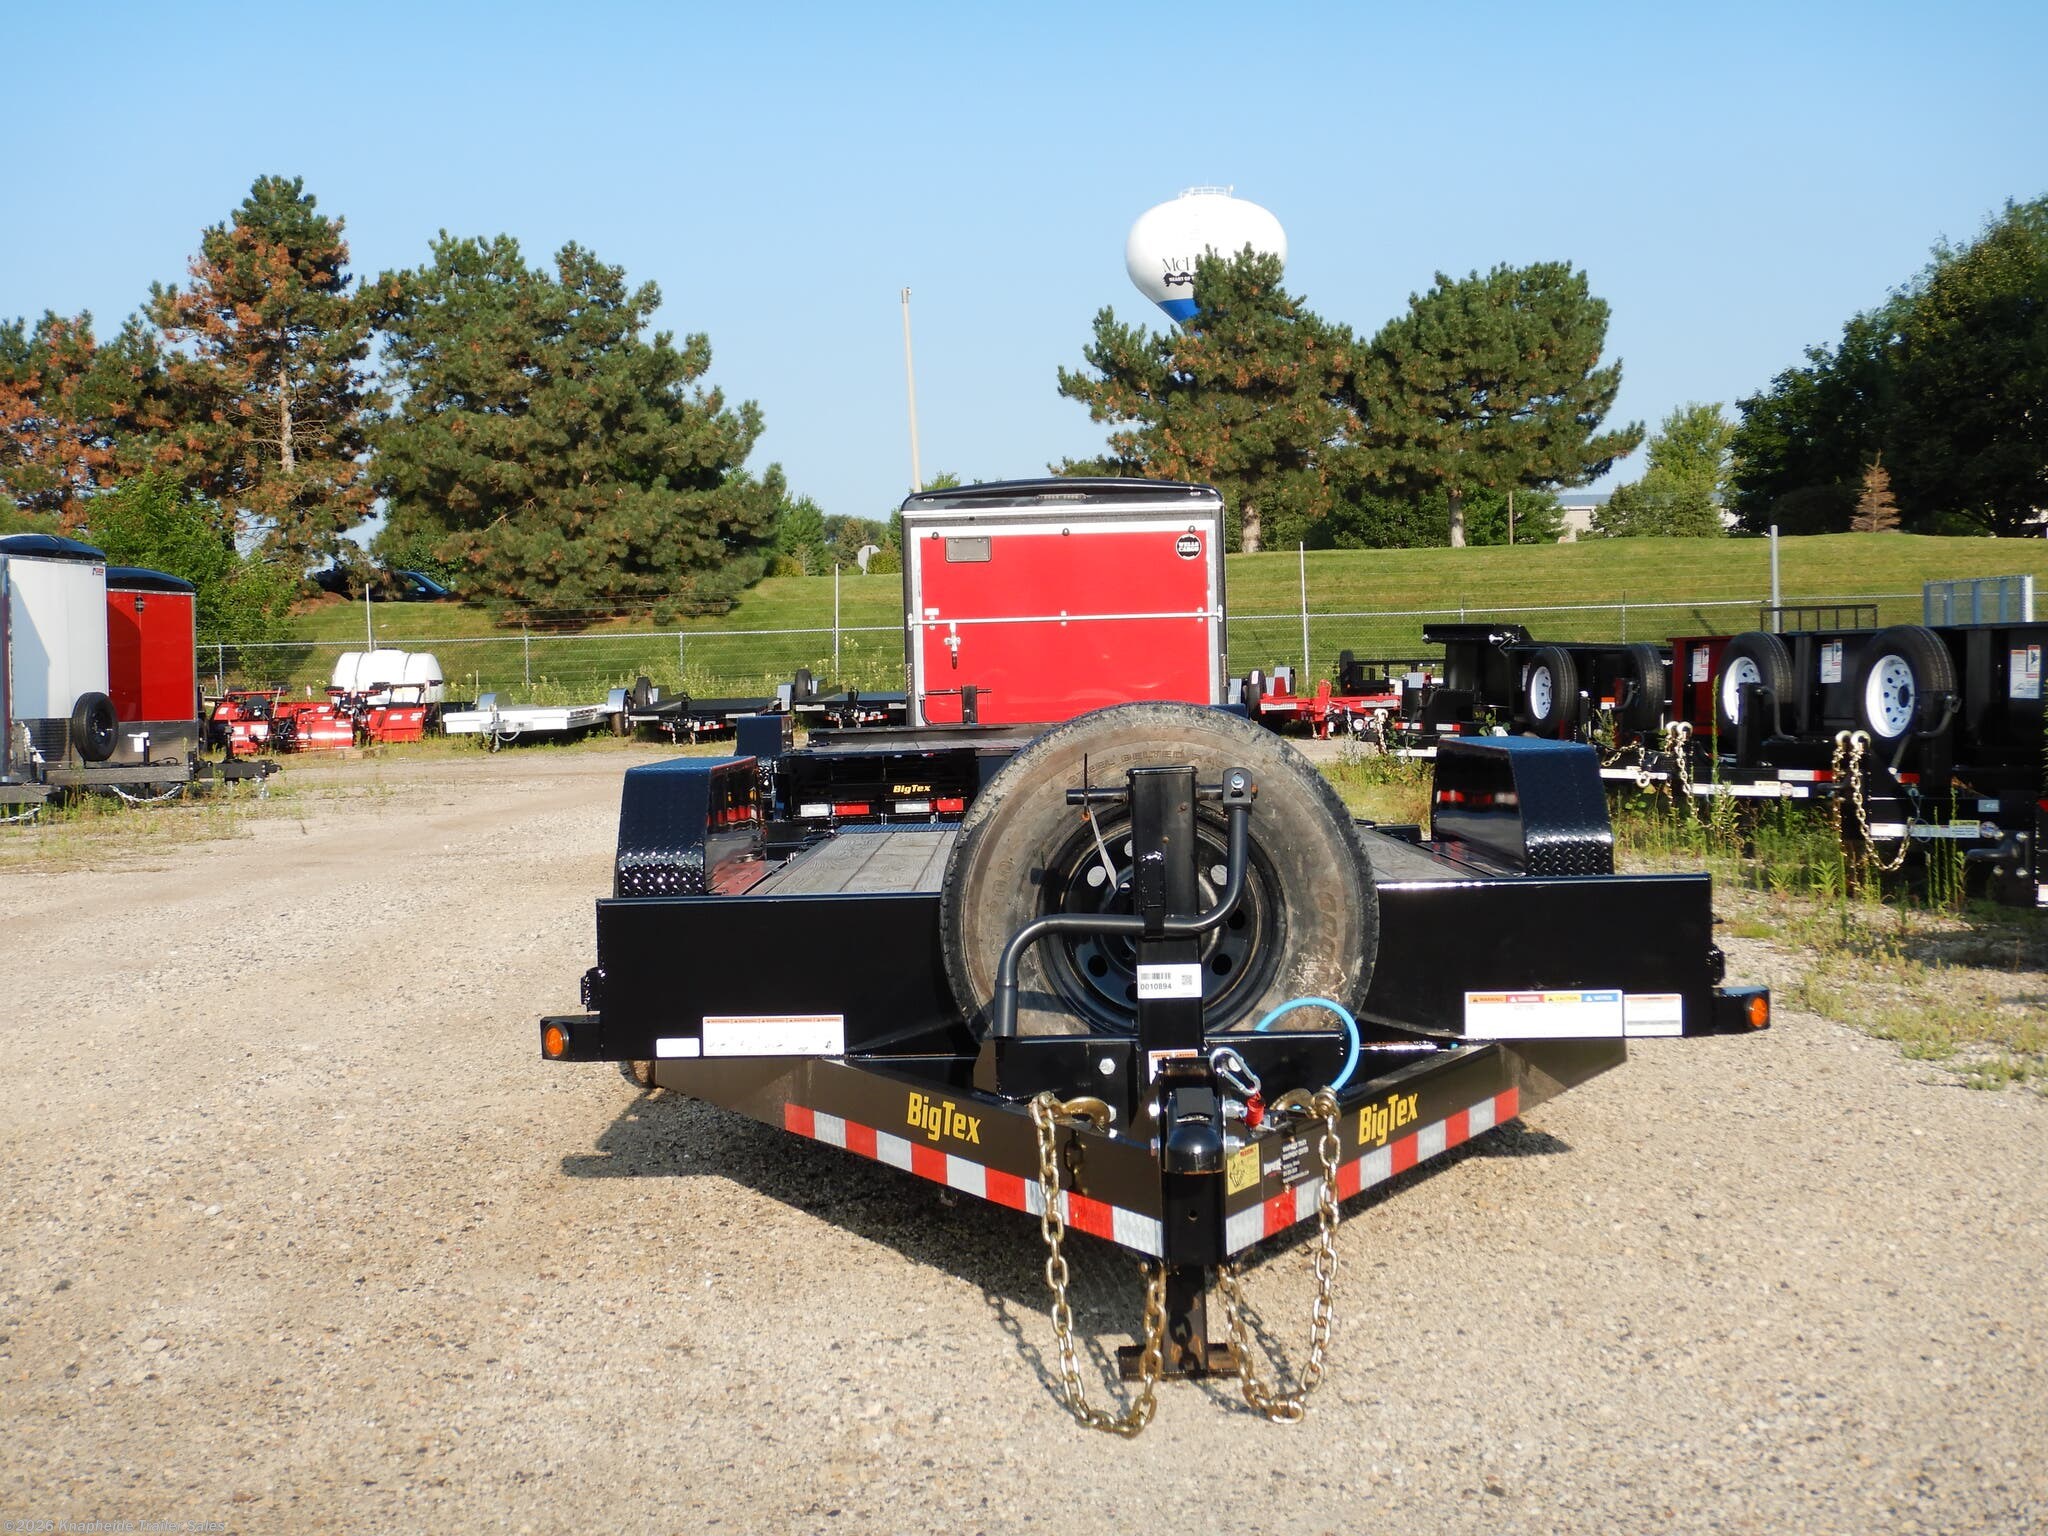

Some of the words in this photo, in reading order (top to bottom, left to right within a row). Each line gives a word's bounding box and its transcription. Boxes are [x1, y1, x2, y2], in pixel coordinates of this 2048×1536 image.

[893, 784, 931, 795] BigTex
[907, 1091, 981, 1144] BigTex
[1358, 1093, 1418, 1147] BigTex
